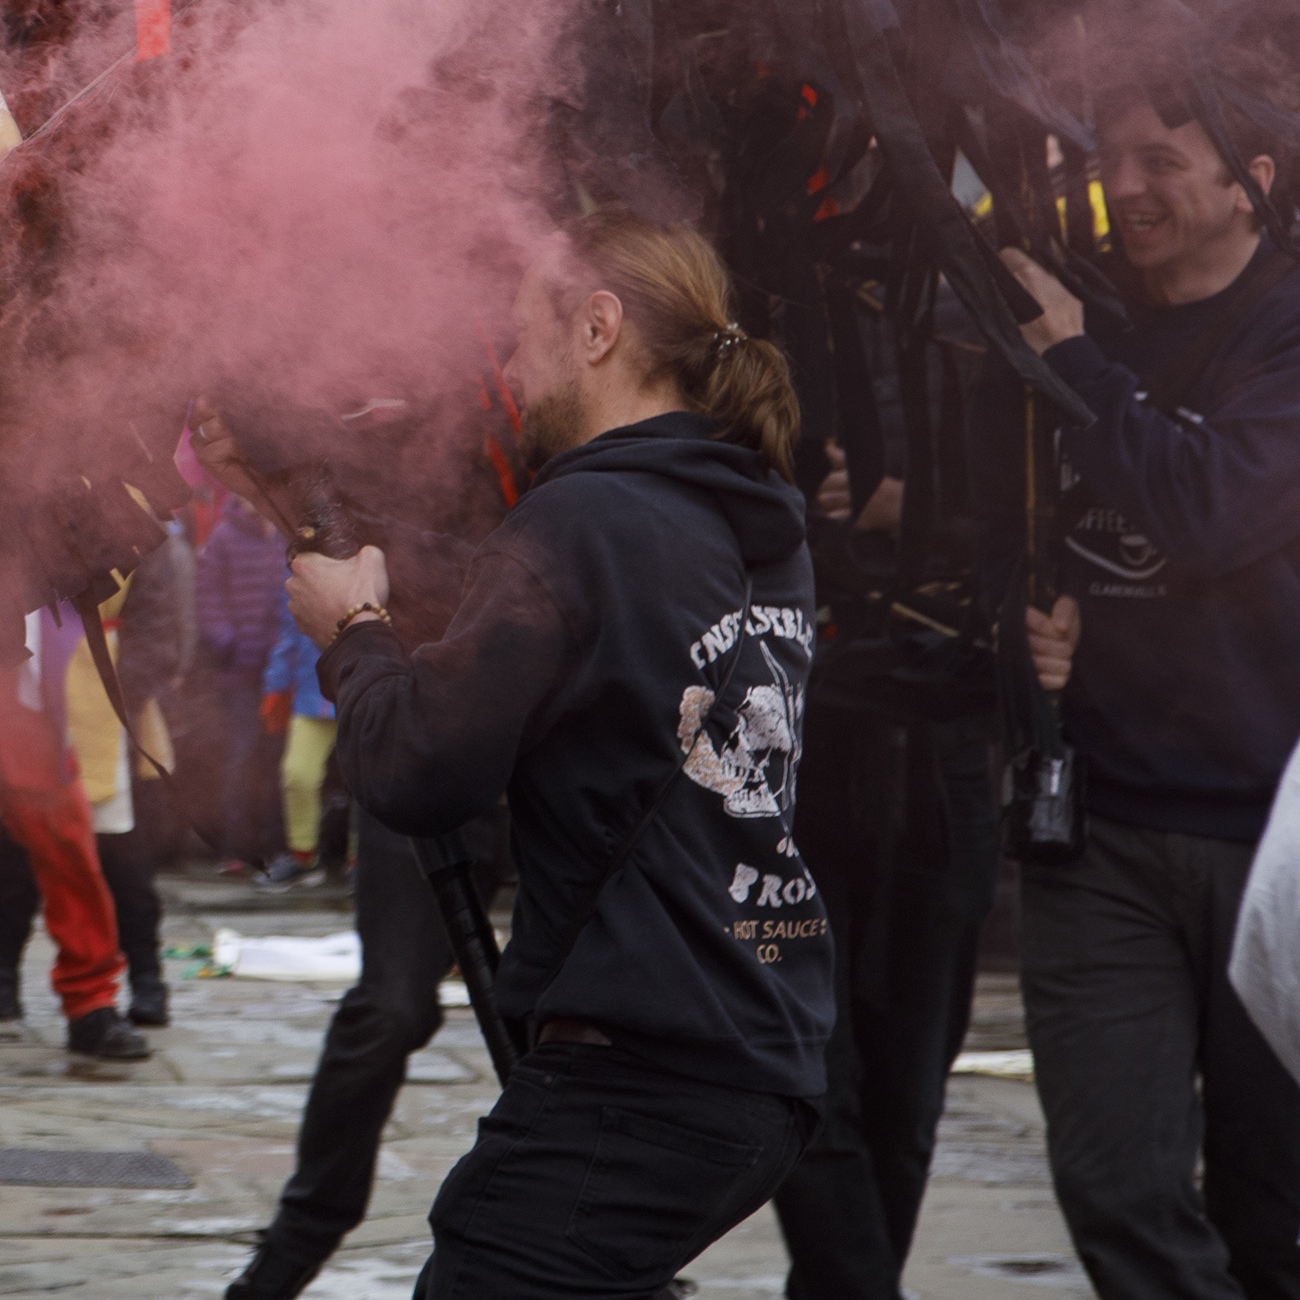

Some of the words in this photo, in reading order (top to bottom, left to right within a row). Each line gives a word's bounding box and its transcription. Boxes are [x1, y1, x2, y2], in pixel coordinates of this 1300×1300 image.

[733, 919, 759, 940] HOT
[761, 918, 819, 939] SAUCE
[756, 943, 783, 964] CO.
